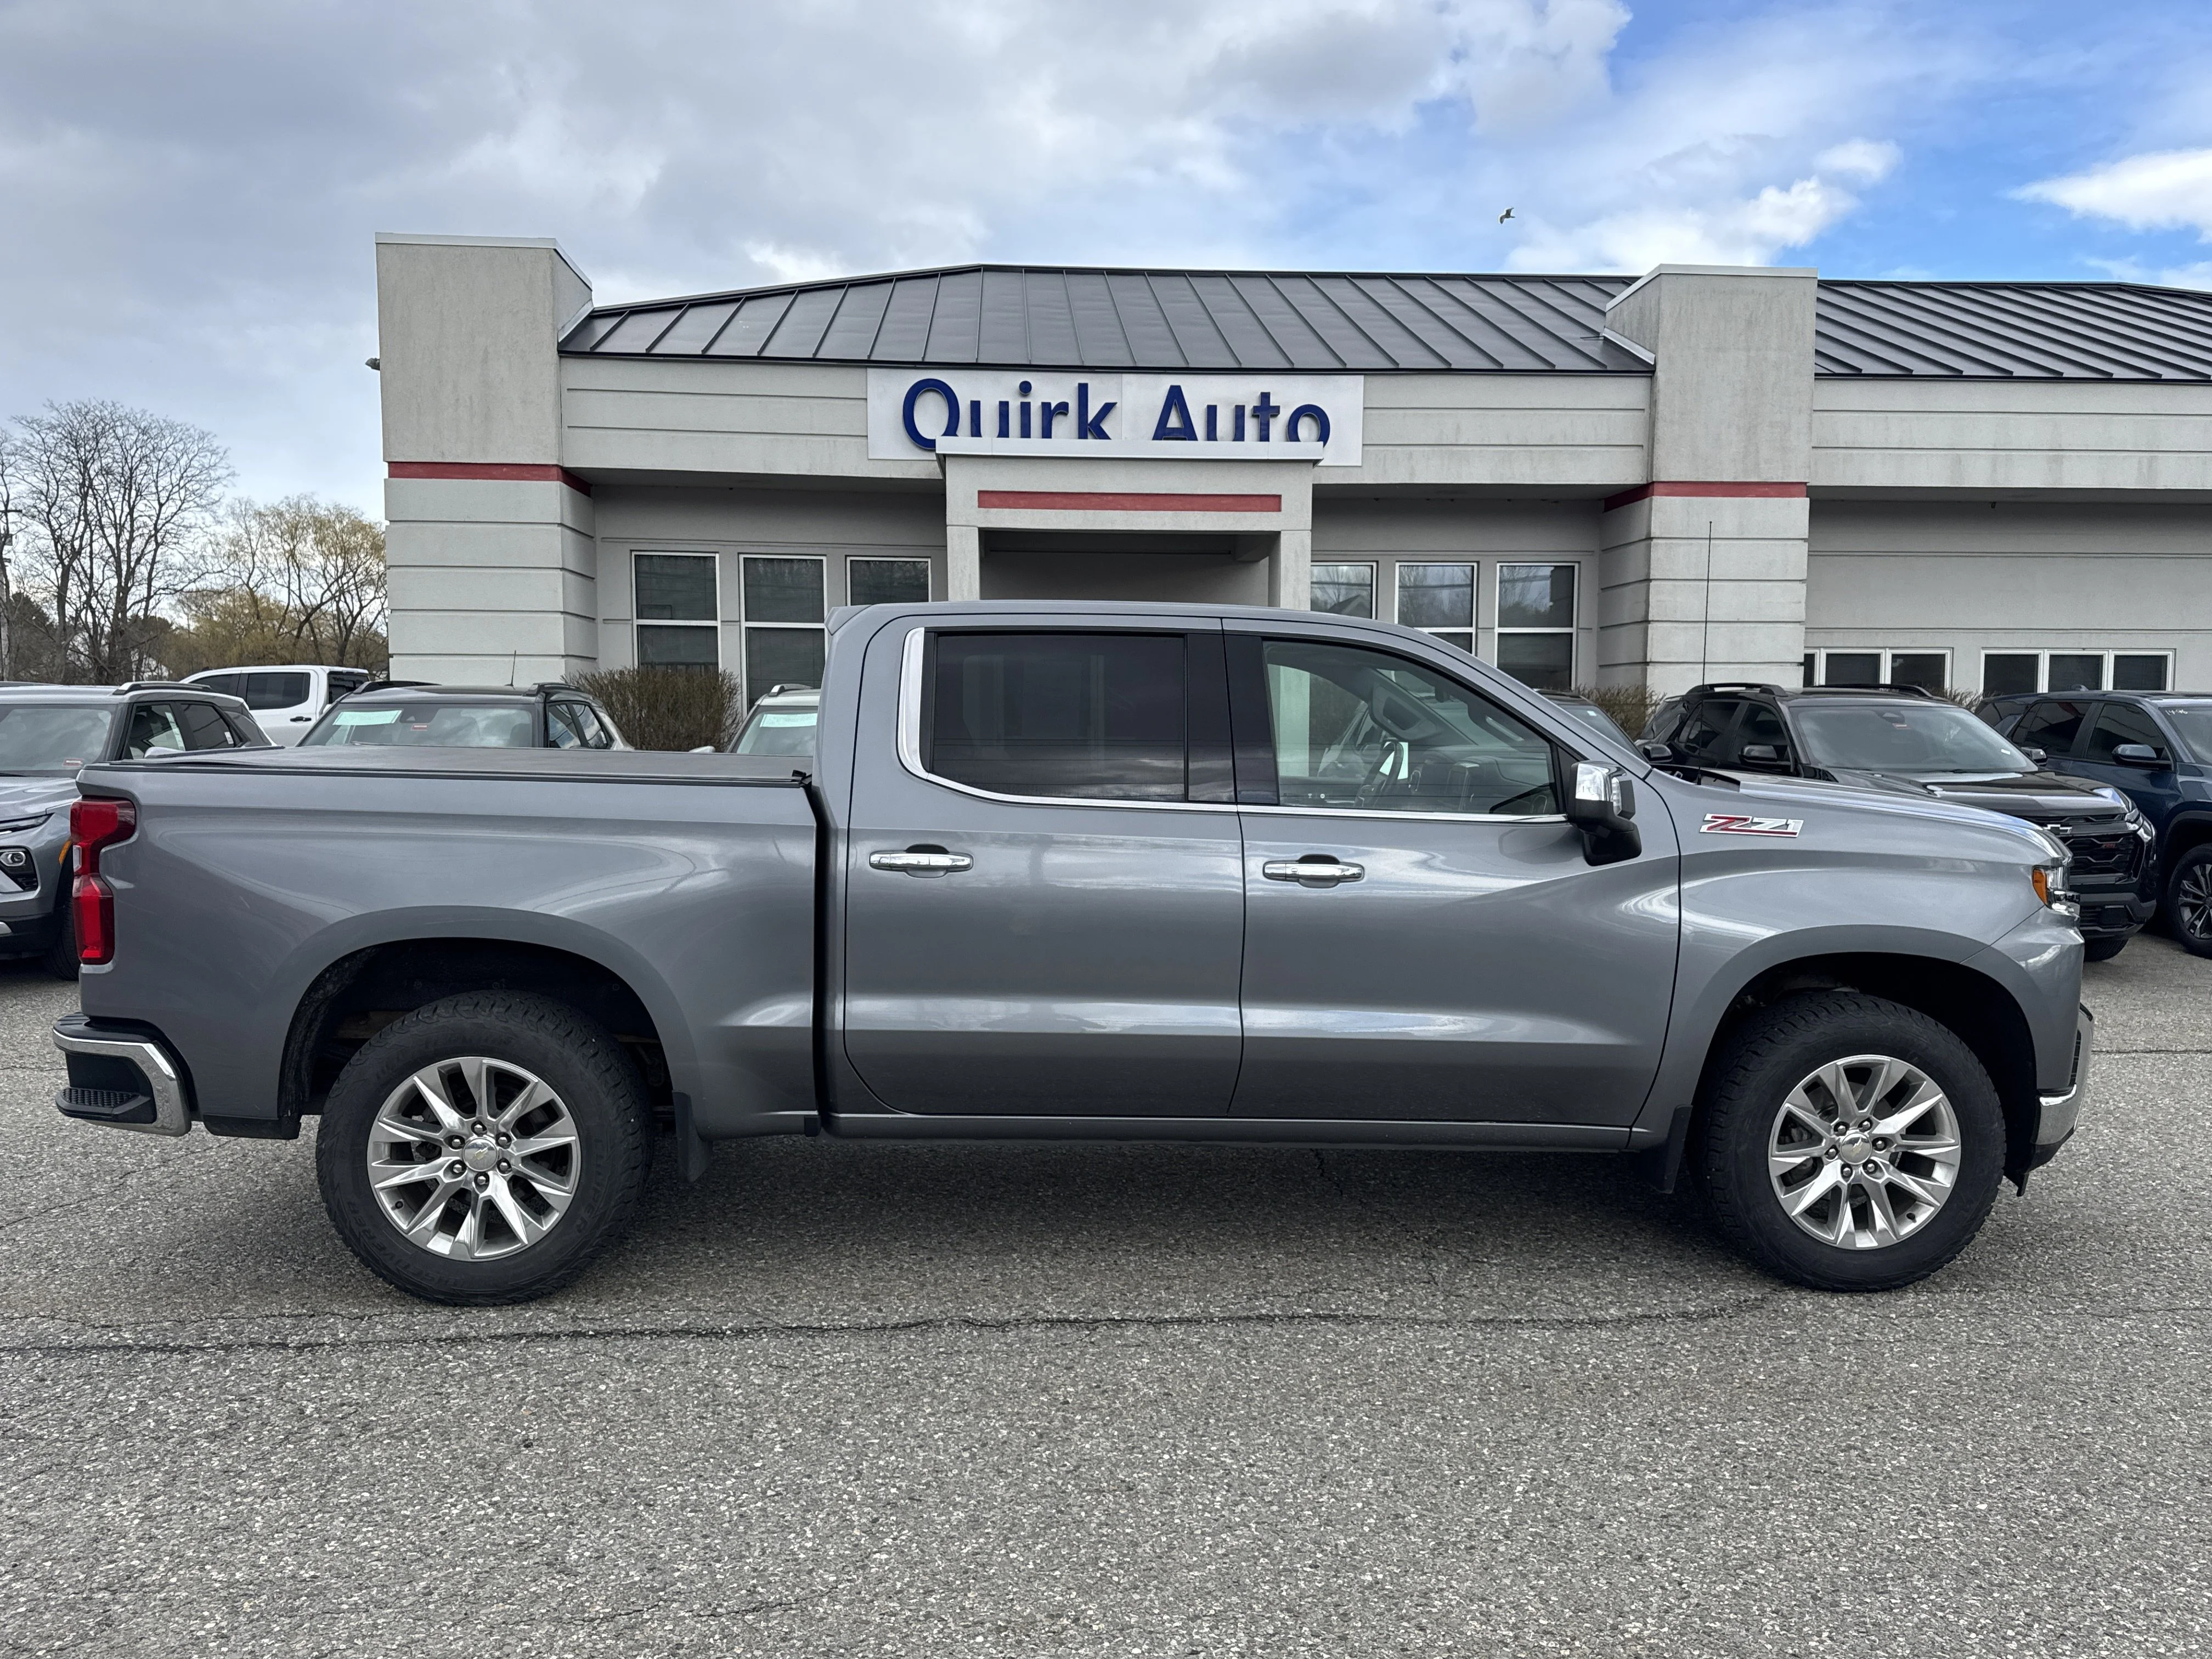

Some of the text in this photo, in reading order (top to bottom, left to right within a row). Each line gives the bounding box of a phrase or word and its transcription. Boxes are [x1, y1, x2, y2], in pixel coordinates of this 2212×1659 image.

[902, 378, 1330, 450] Quirk Auto
[1699, 813, 1804, 838] Z71
